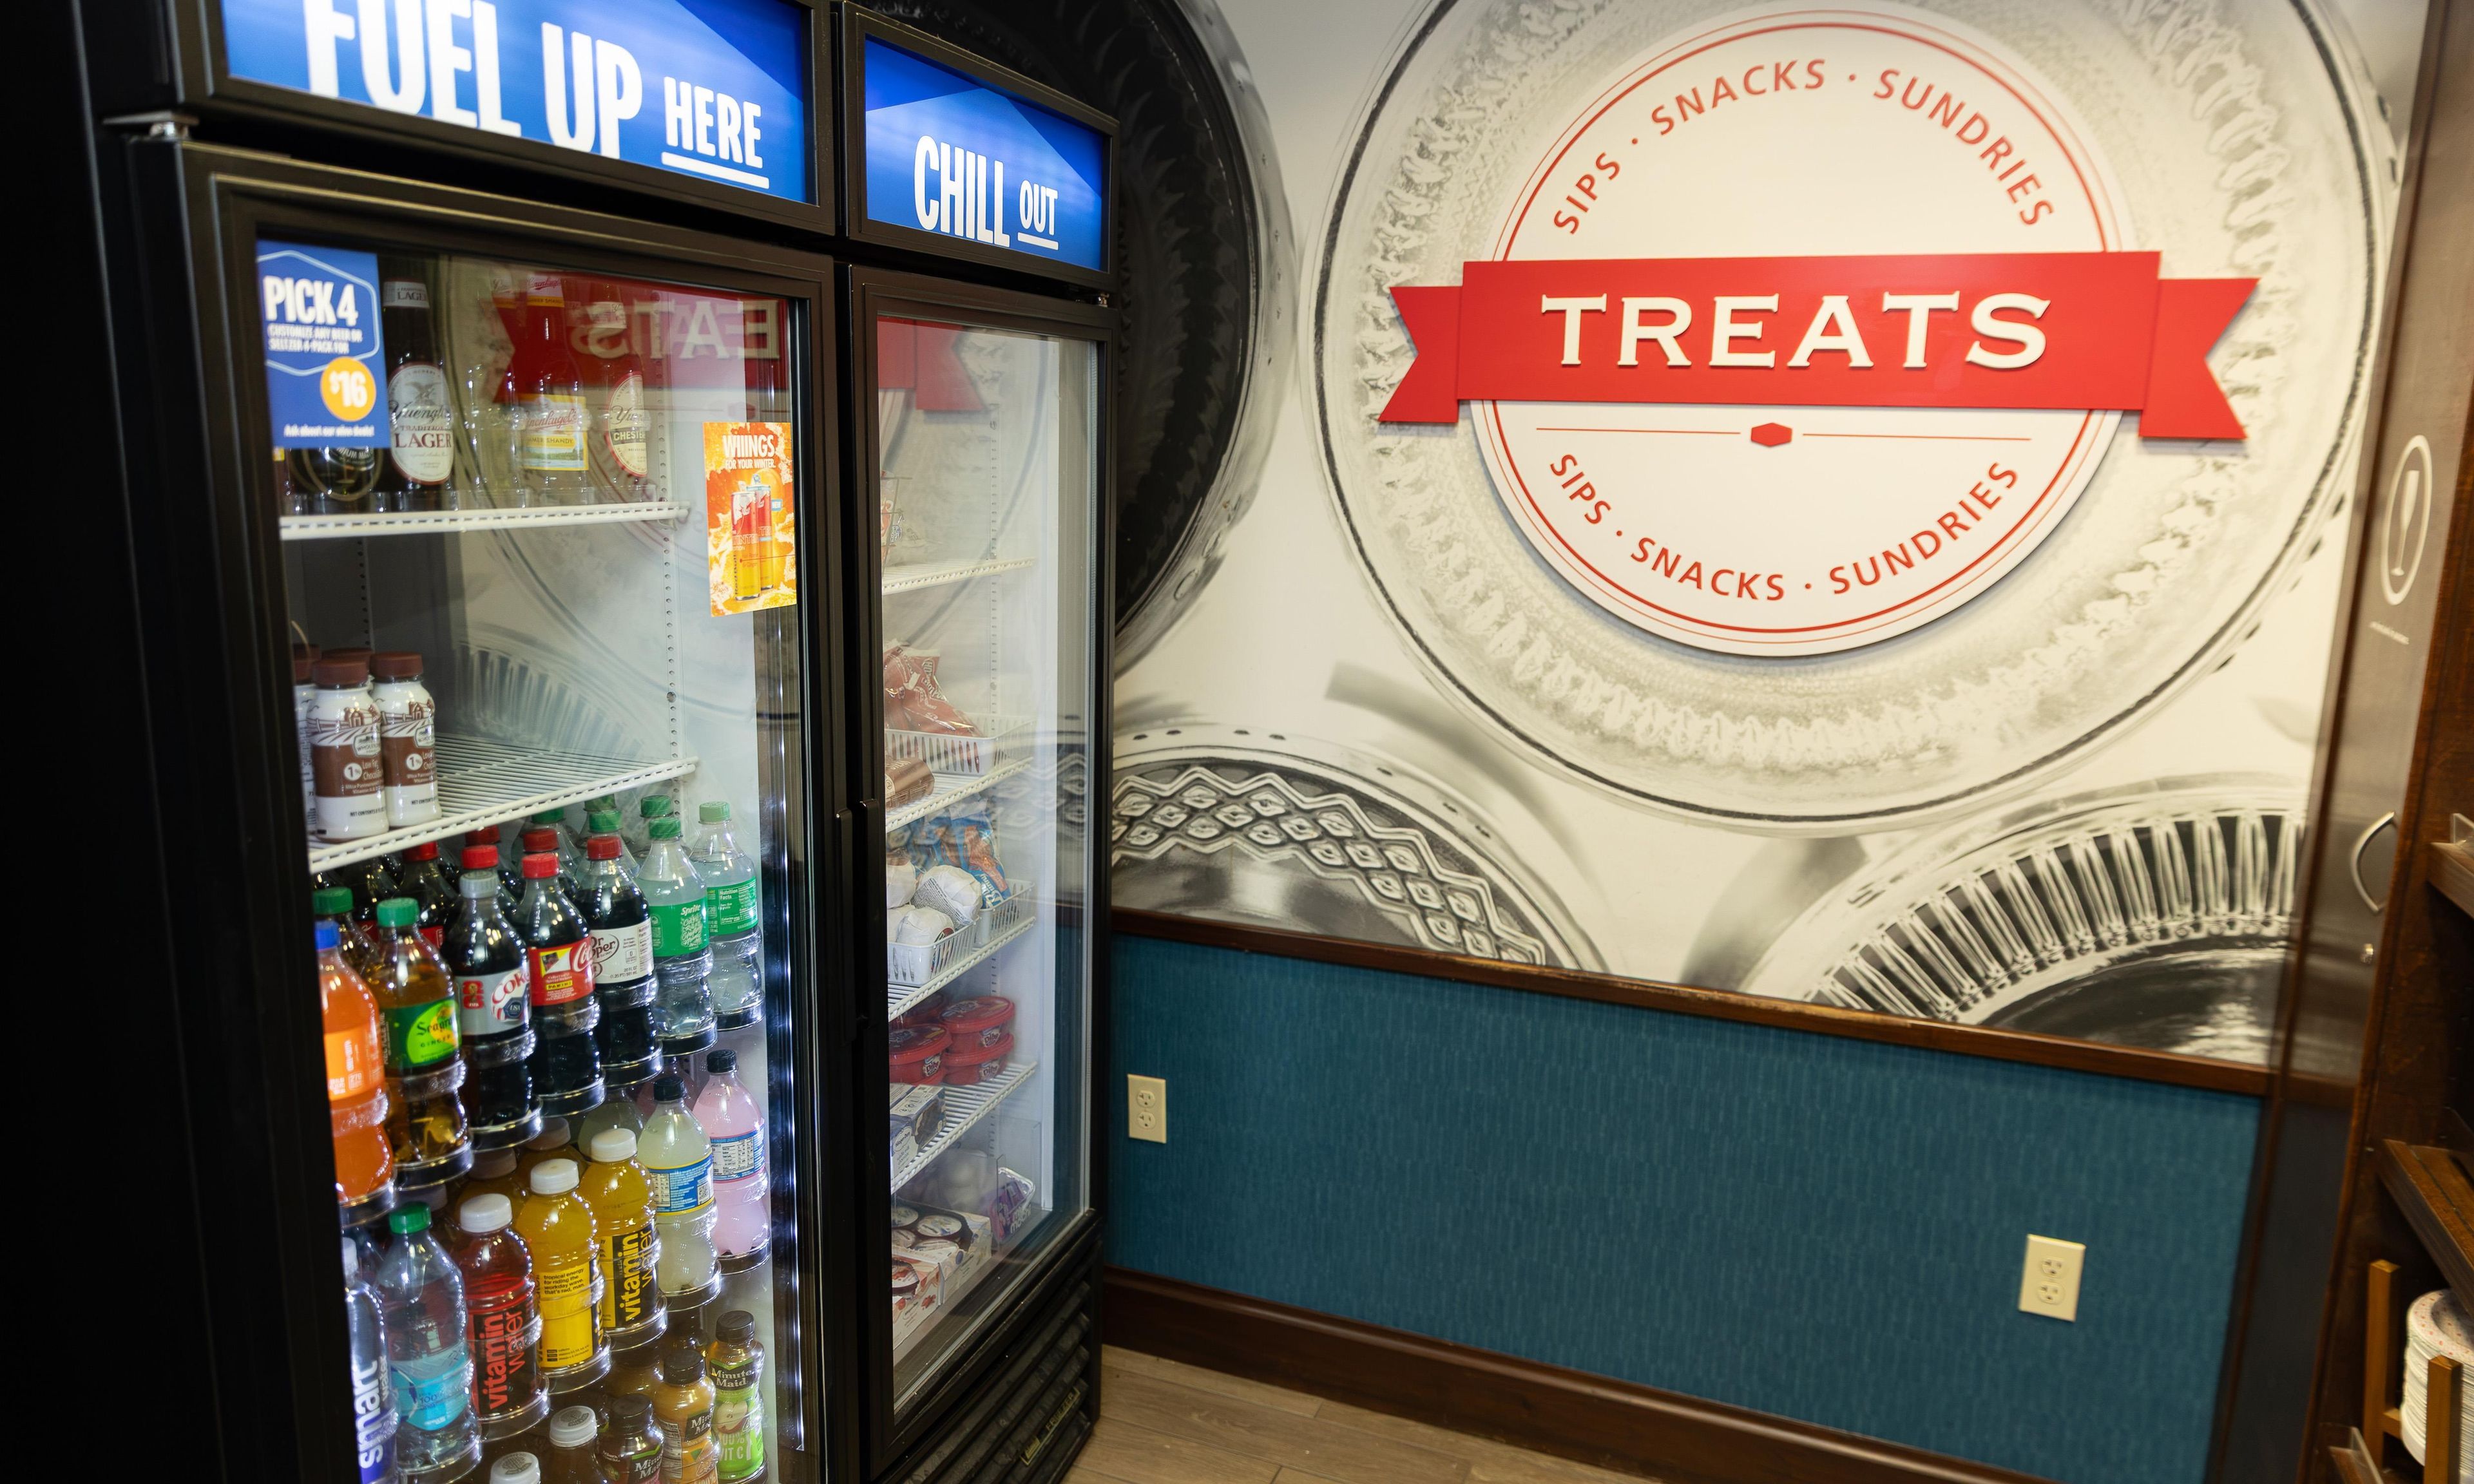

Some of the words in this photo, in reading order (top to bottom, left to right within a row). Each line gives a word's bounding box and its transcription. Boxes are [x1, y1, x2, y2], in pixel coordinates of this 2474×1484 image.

[304, 0, 521, 138] FUEL
[542, 21, 642, 159] UP
[664, 77, 763, 169] HERE
[1553, 153, 1621, 234] SIPS
[1651, 59, 1825, 135] SNACKS
[1874, 69, 2053, 226] SUNDRIES
[914, 135, 1010, 248] CHILL
[1019, 180, 1059, 236] OUT
[263, 275, 337, 325] PICK
[336, 283, 359, 327] 4
[1541, 292, 2051, 370] TREATS
[329, 370, 367, 408] $16
[395, 433, 452, 448] LAGER
[722, 434, 776, 458] WIIINGS
[726, 459, 737, 469] FOR
[738, 459, 753, 469] YOUR
[1549, 454, 1612, 525] SIPS
[1630, 537, 1785, 602] SNACKS
[1828, 463, 2018, 595] SUNDRIES
[680, 904, 701, 916] Sprite
[492, 971, 530, 1005] Coke
[552, 1277, 569, 1286] riding
[566, 1268, 584, 1277] energy
[618, 1233, 641, 1322] vitamin
[479, 1313, 508, 1410] vitamin
[506, 1311, 526, 1375] water
[711, 1367, 754, 1380] Minute
[716, 1377, 747, 1388] Maid
